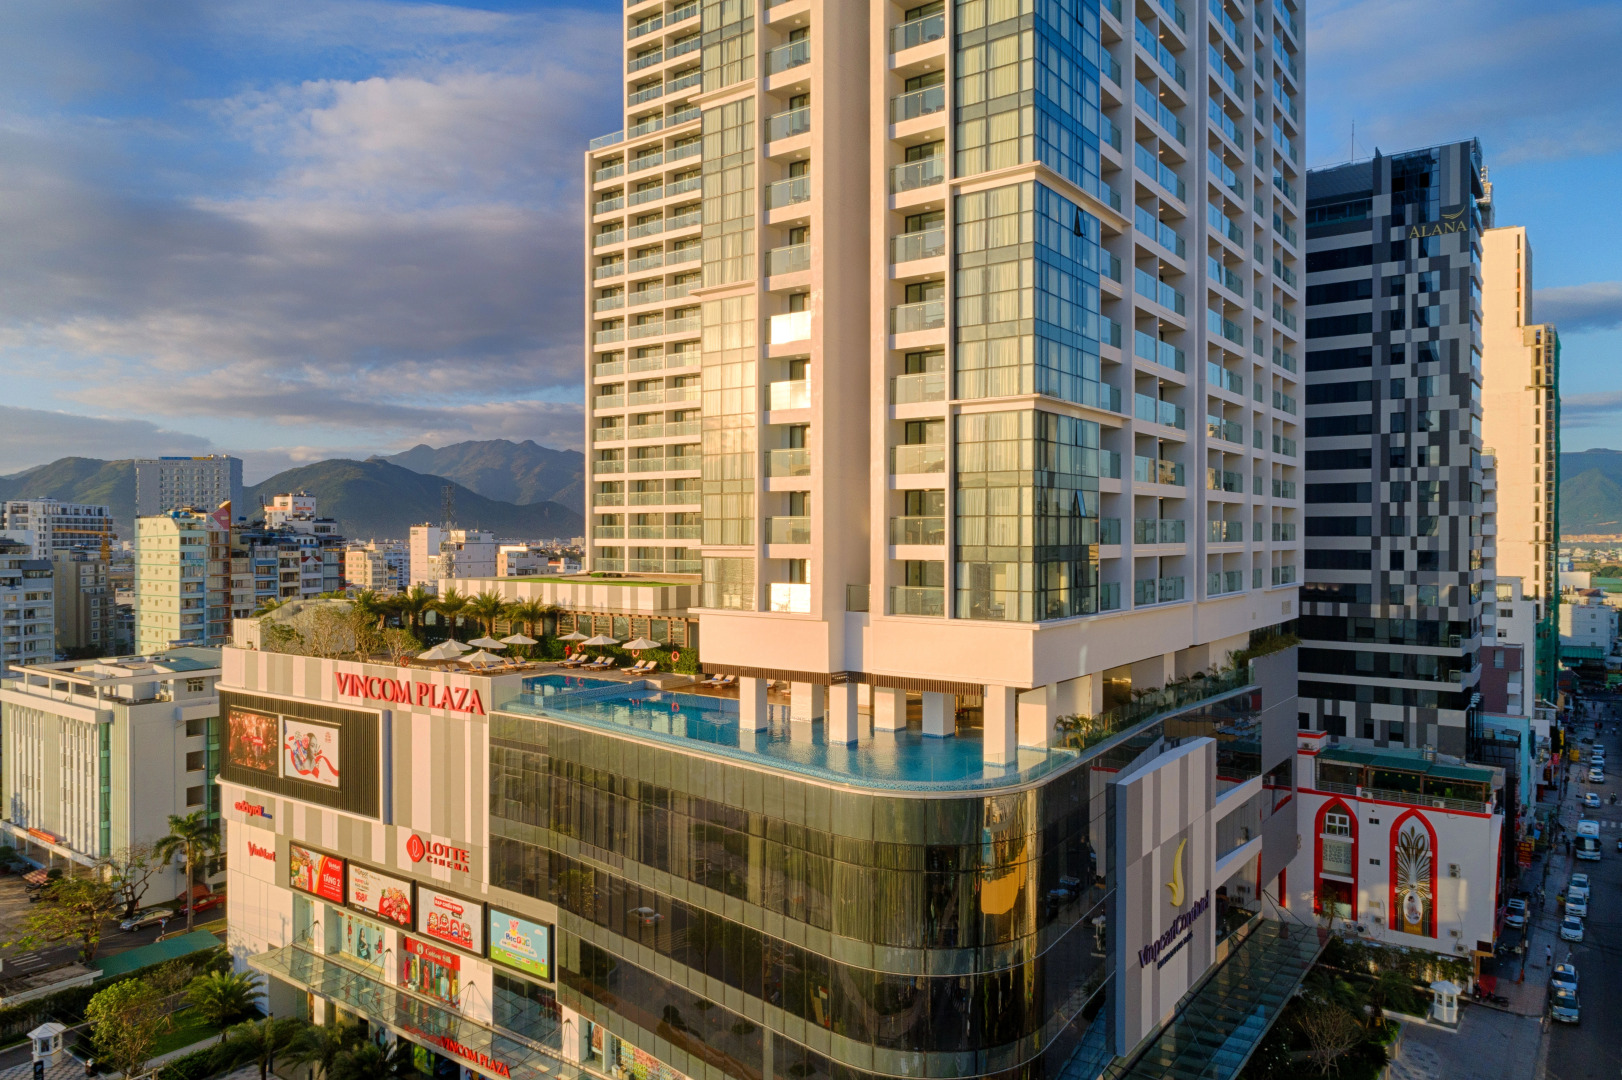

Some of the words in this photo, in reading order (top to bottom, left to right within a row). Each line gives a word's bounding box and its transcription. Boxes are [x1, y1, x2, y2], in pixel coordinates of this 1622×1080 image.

[1409, 220, 1468, 239] ALANA
[334, 671, 413, 705] VINCOM
[415, 681, 486, 716] PLAZA
[425, 840, 470, 864] LOTTE
[425, 855, 470, 873] CINEMA
[441, 1035, 478, 1064] VINCOM
[479, 1053, 511, 1079] PLAZA
